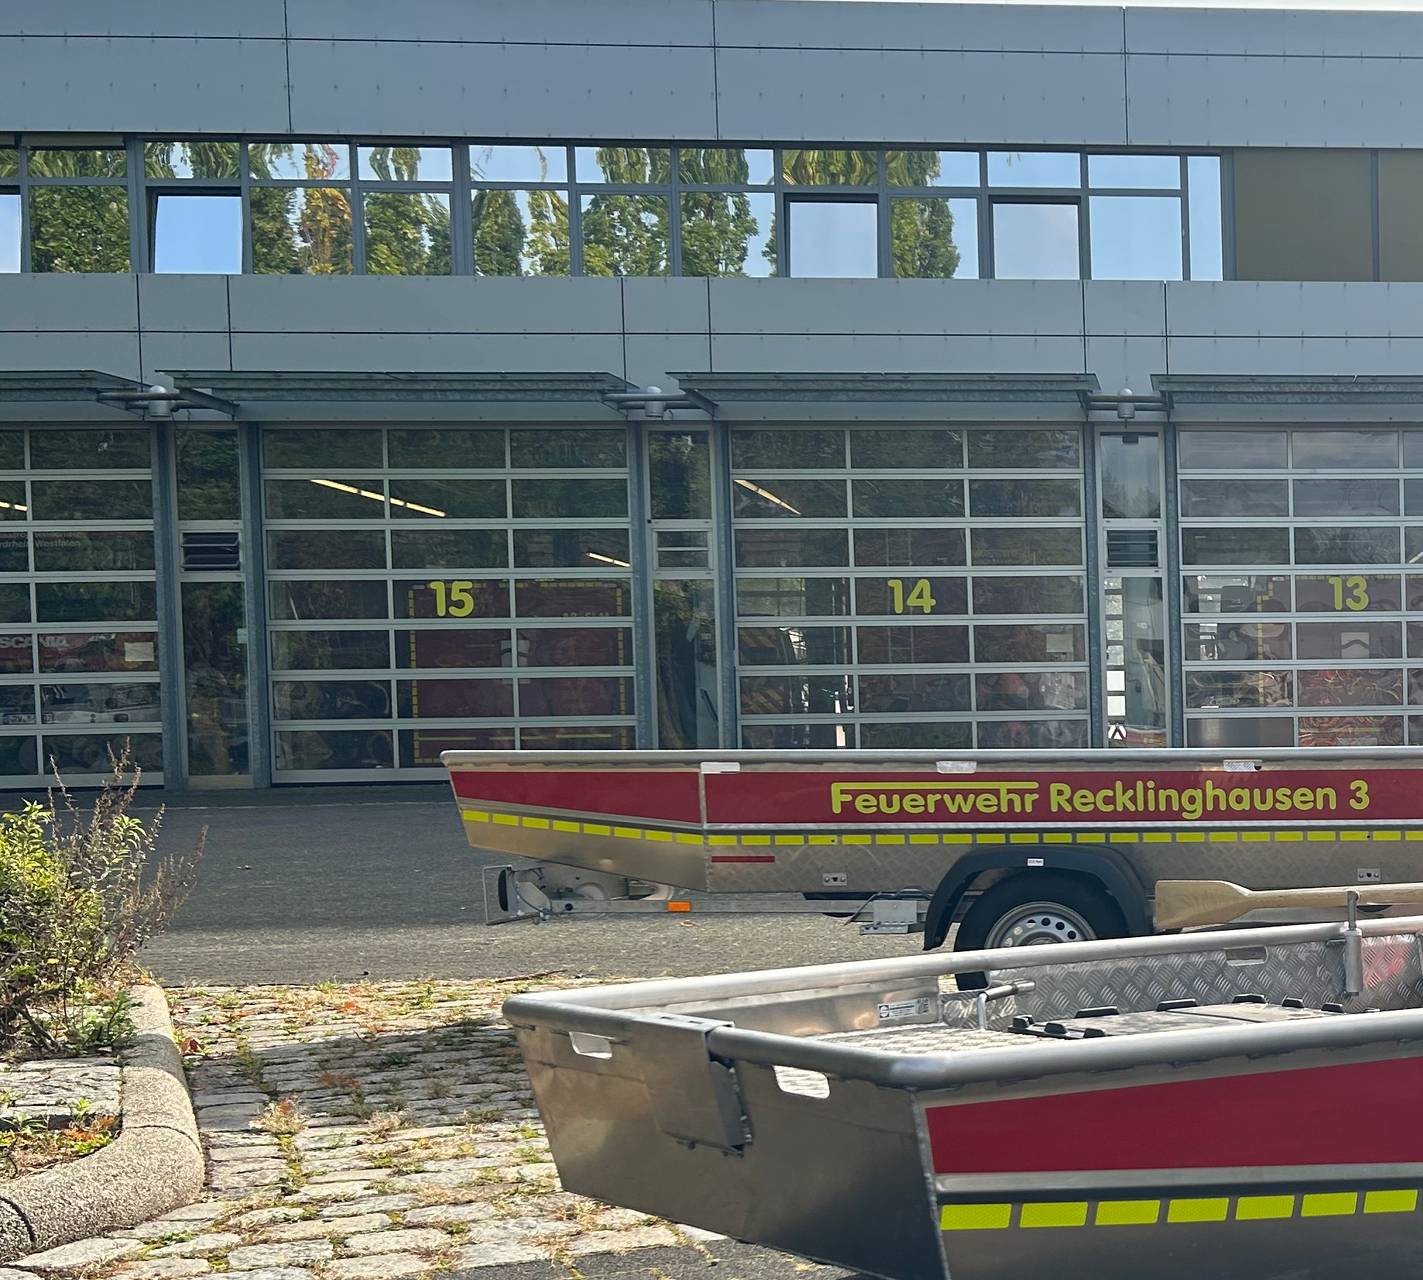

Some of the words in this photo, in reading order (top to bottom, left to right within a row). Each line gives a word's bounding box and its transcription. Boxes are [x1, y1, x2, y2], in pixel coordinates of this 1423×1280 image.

[429, 580, 474, 617] 15
[887, 578, 937, 614] 14
[1328, 575, 1369, 611] 13
[831, 781, 1039, 815] Feuerwehr
[1049, 779, 1337, 820] Recklinghausen
[1349, 780, 1371, 811] 3
